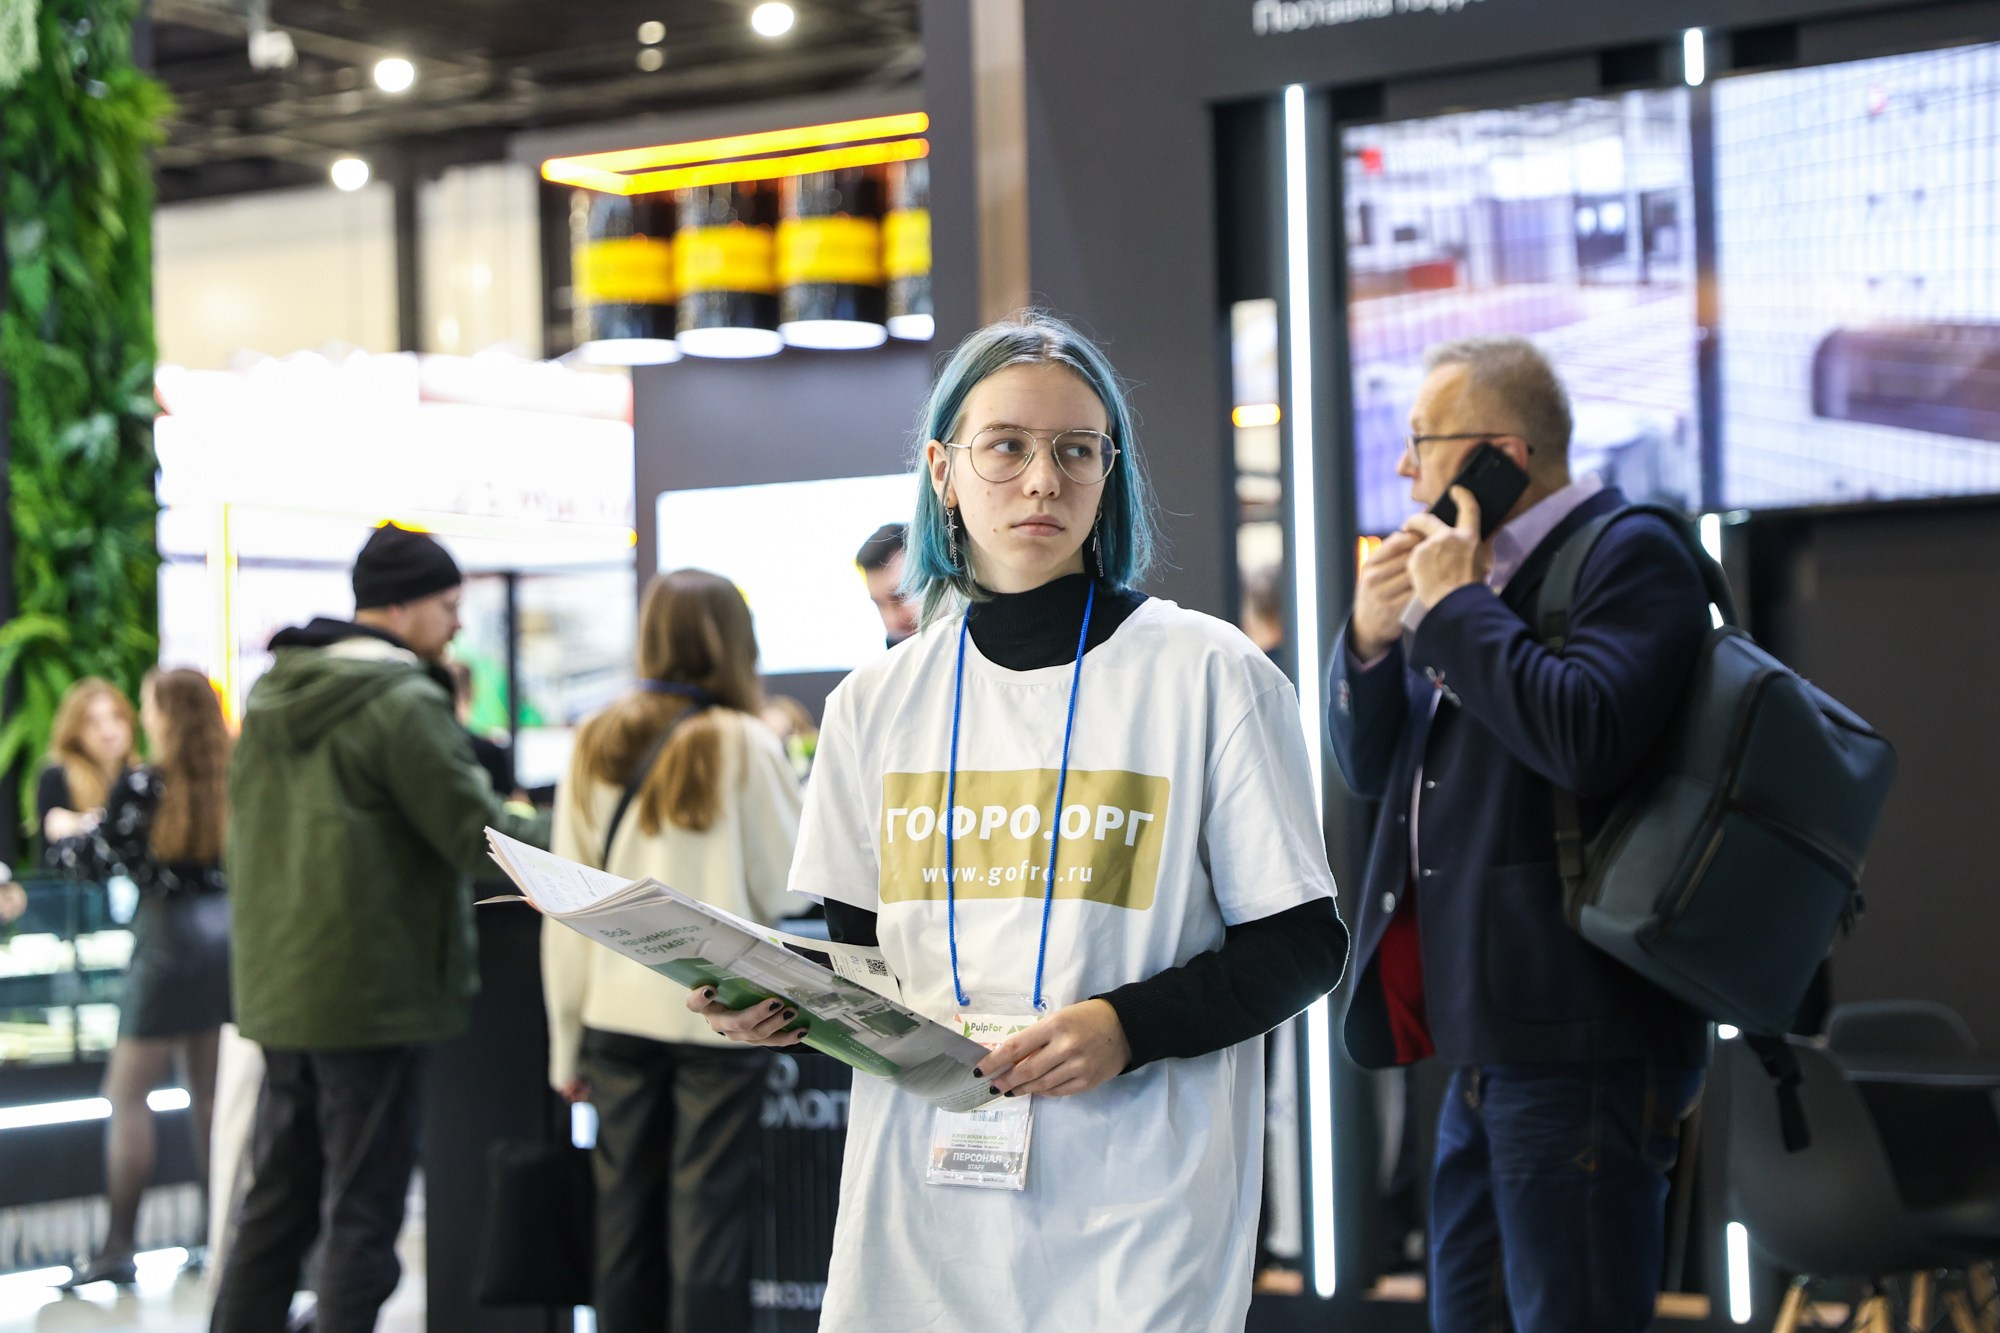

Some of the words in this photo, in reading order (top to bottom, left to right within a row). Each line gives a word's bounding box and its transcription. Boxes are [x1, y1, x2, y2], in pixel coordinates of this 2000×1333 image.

[886, 803, 1154, 846] ГОФРО.ОРГ
[644, 935, 700, 954] бумаги
[970, 1022, 1003, 1034] PulpFor
[953, 1152, 1002, 1164] ПЕРСОНАЛ
